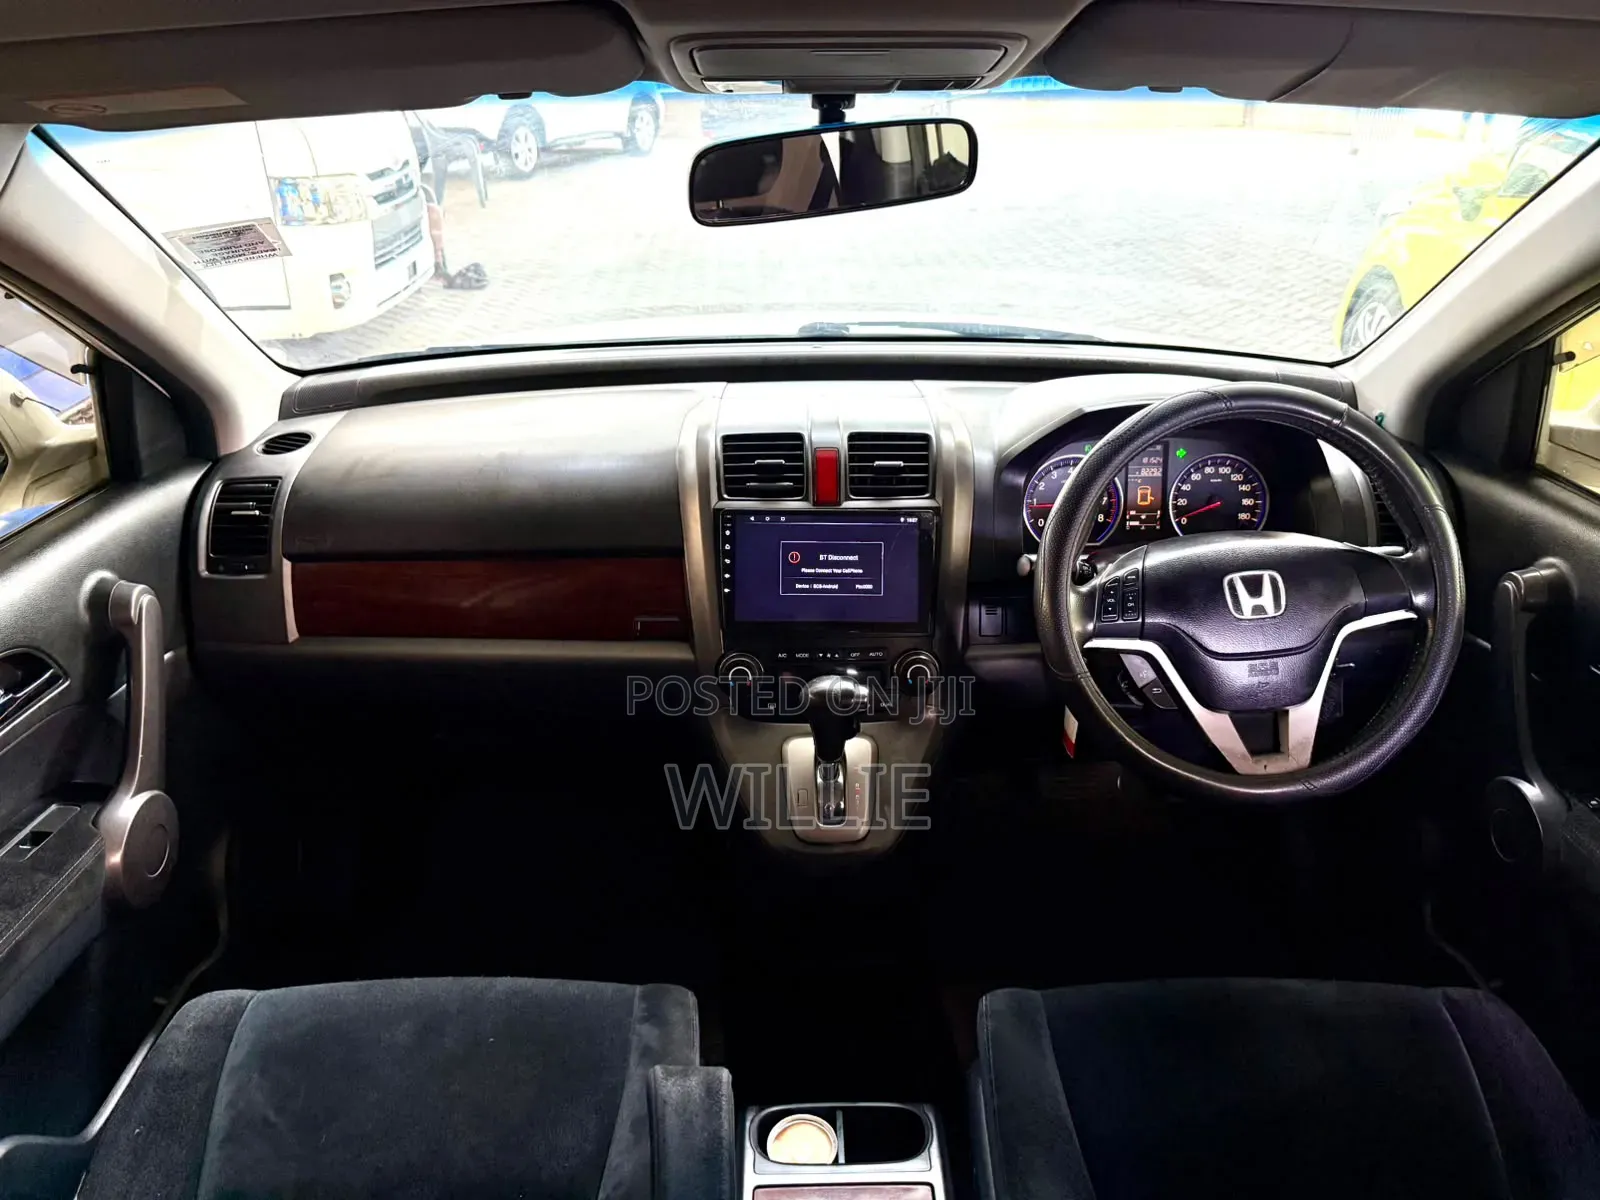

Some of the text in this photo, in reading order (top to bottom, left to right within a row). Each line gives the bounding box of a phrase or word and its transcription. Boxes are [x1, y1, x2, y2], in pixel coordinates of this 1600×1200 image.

[244, 240, 265, 248] AND
[1204, 466, 1215, 474] 80
[1218, 466, 1232, 474] 100
[1050, 471, 1058, 480] 3
[1190, 473, 1202, 481] 60
[1230, 473, 1244, 481] 120
[1038, 482, 1046, 490] 2
[1180, 483, 1192, 492] 40
[1238, 484, 1252, 492] 140
[1101, 496, 1108, 505] 7
[1176, 498, 1188, 506] 20
[1241, 498, 1255, 506] 160
[1097, 513, 1105, 523] 8
[1180, 517, 1187, 525] 0
[1037, 518, 1045, 527] 0
